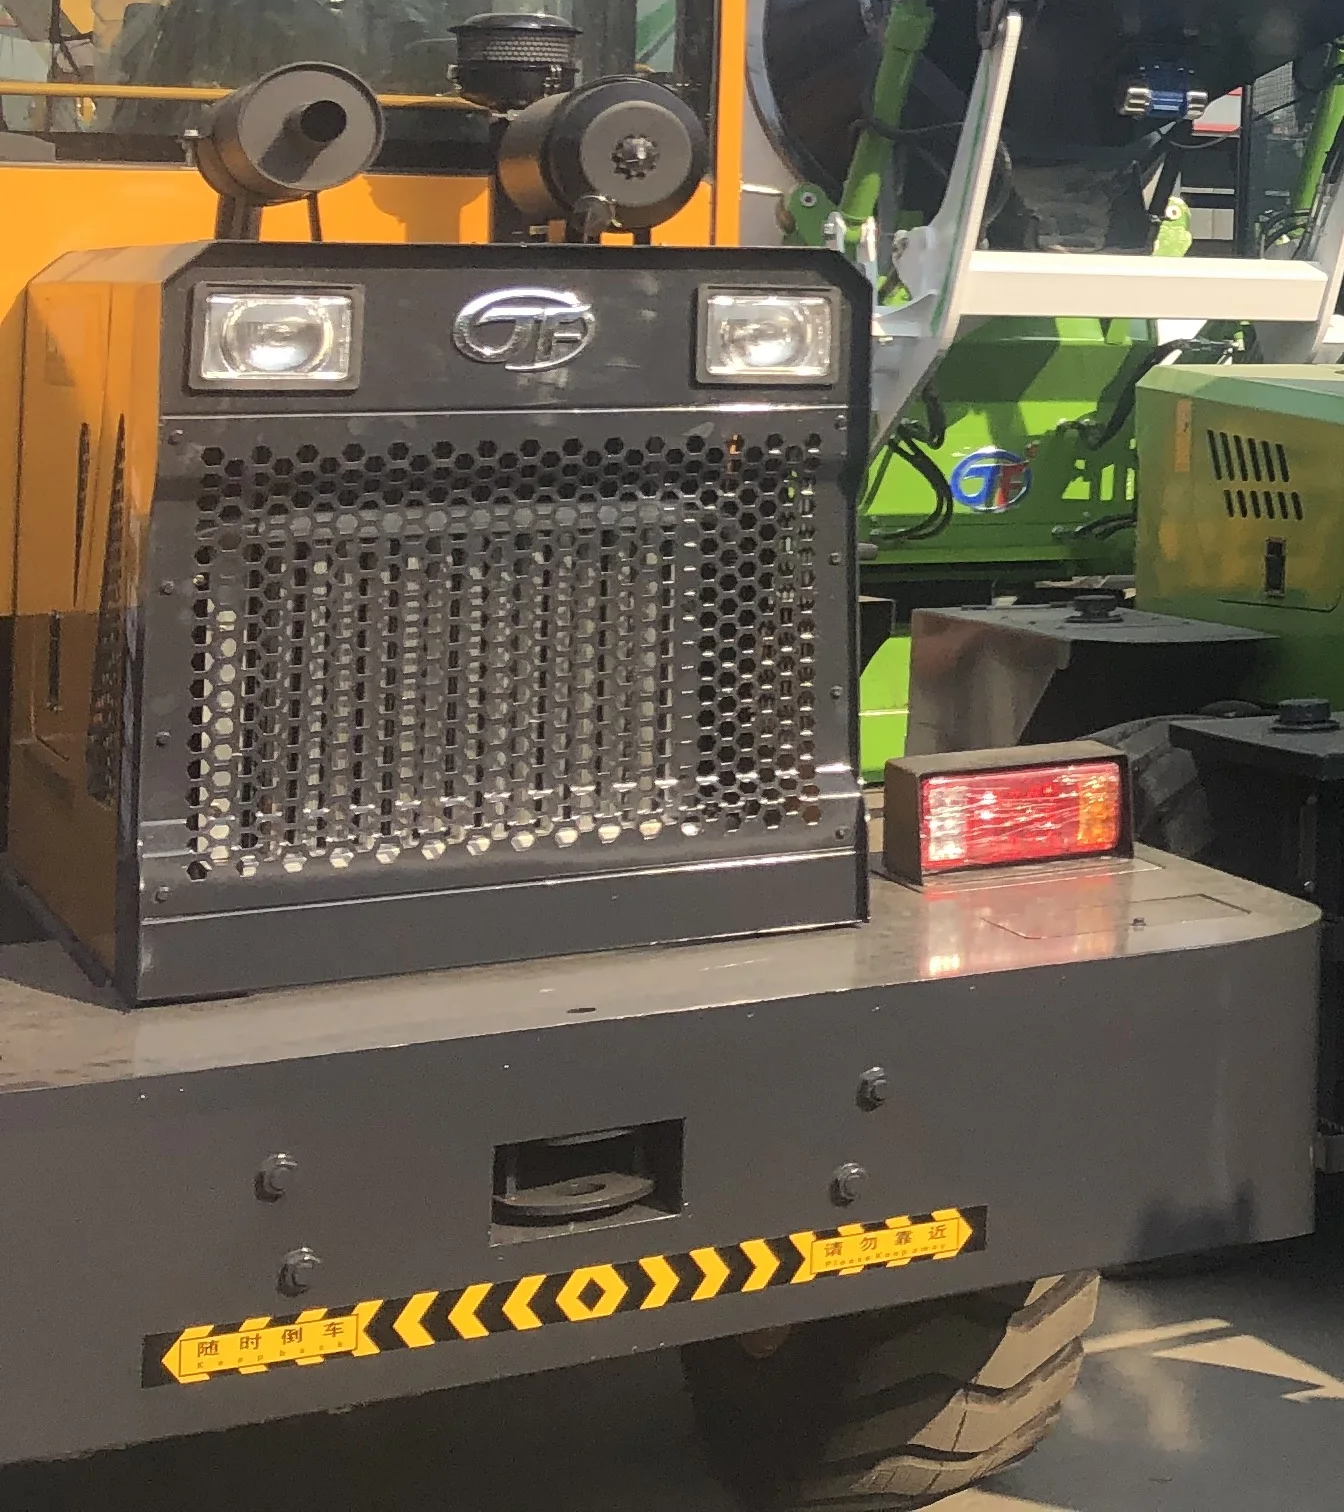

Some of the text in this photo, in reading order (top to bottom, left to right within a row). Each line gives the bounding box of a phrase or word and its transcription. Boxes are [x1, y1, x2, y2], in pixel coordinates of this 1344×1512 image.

[824, 1223, 948, 1258] 请勿靠近
[197, 1321, 345, 1358] 随时倒车
